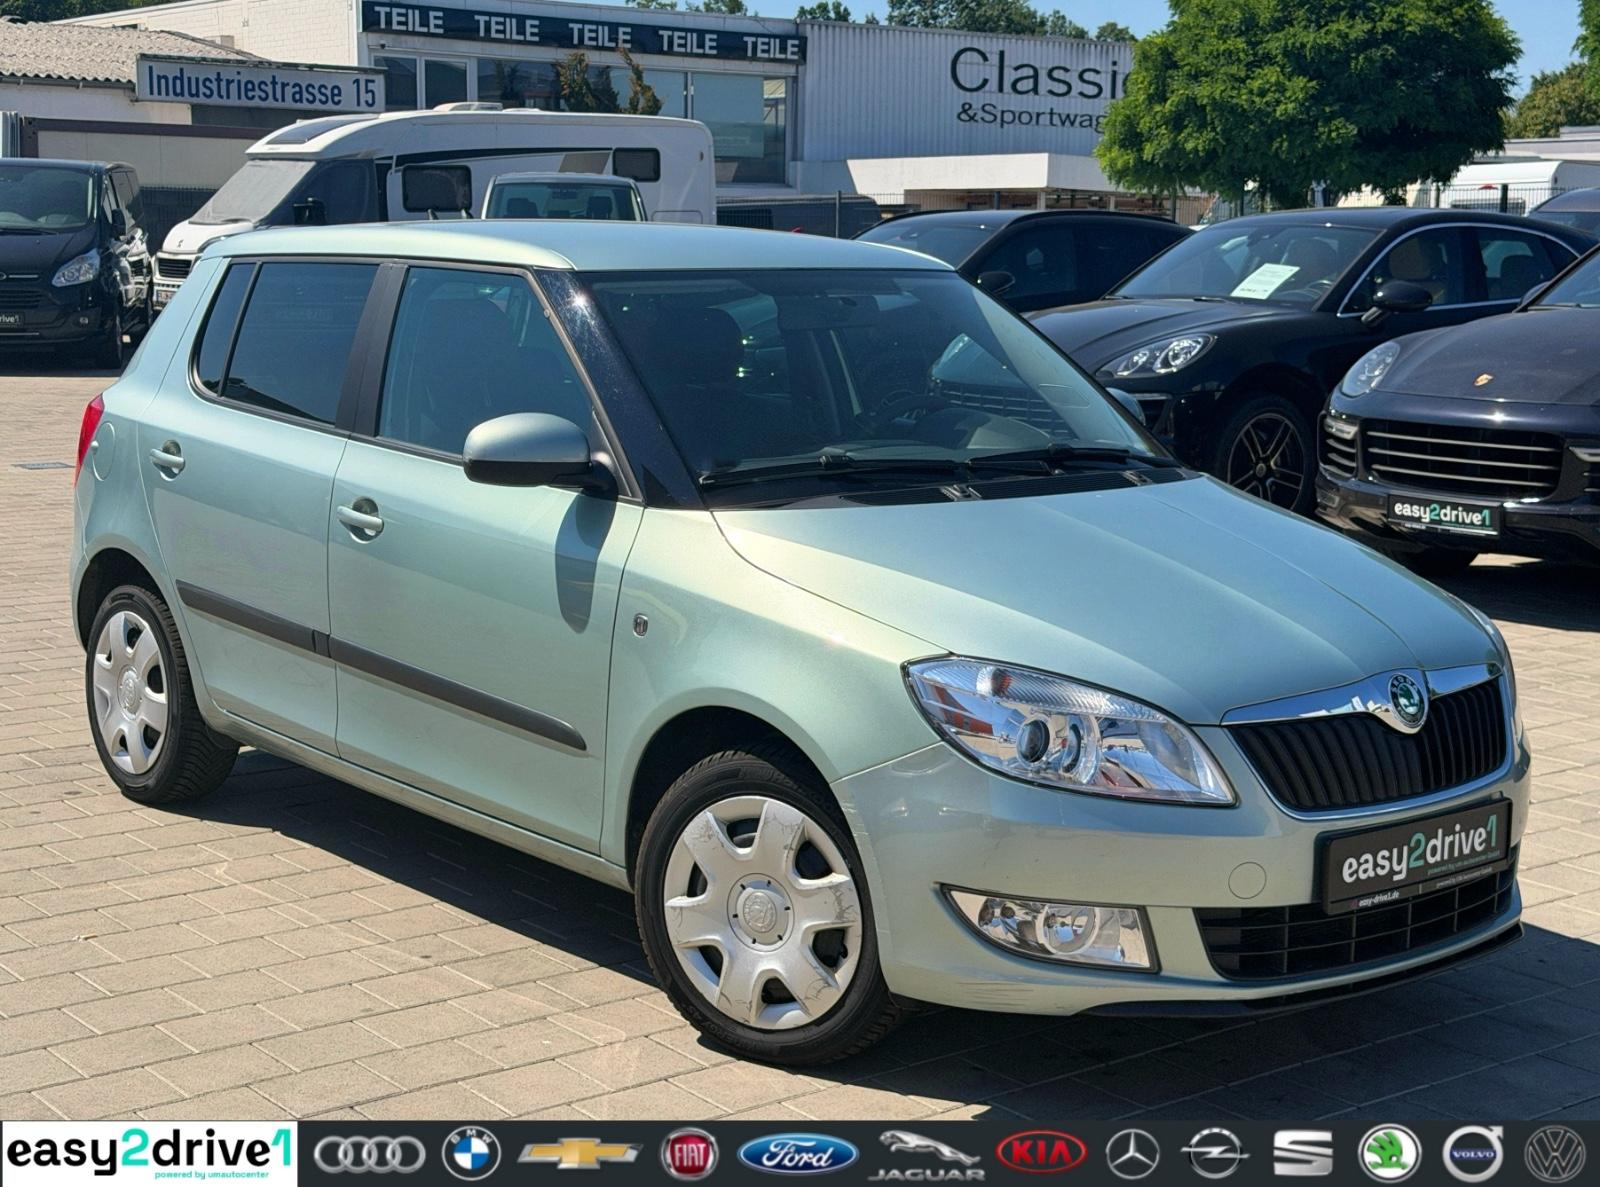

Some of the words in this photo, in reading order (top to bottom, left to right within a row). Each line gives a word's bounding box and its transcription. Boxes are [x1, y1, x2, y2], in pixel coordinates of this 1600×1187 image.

[374, 5, 444, 34] TEILE
[474, 15, 540, 42] TEILE
[569, 23, 632, 49] TEILE
[658, 30, 718, 55] TEILE
[743, 36, 799, 60] TEILE
[148, 65, 342, 106] Industriestrasse
[352, 78, 376, 108] 15
[956, 102, 1104, 134] &Sportwag
[1394, 502, 1491, 526] easy2drive1
[1342, 814, 1497, 883] easy2drive1
